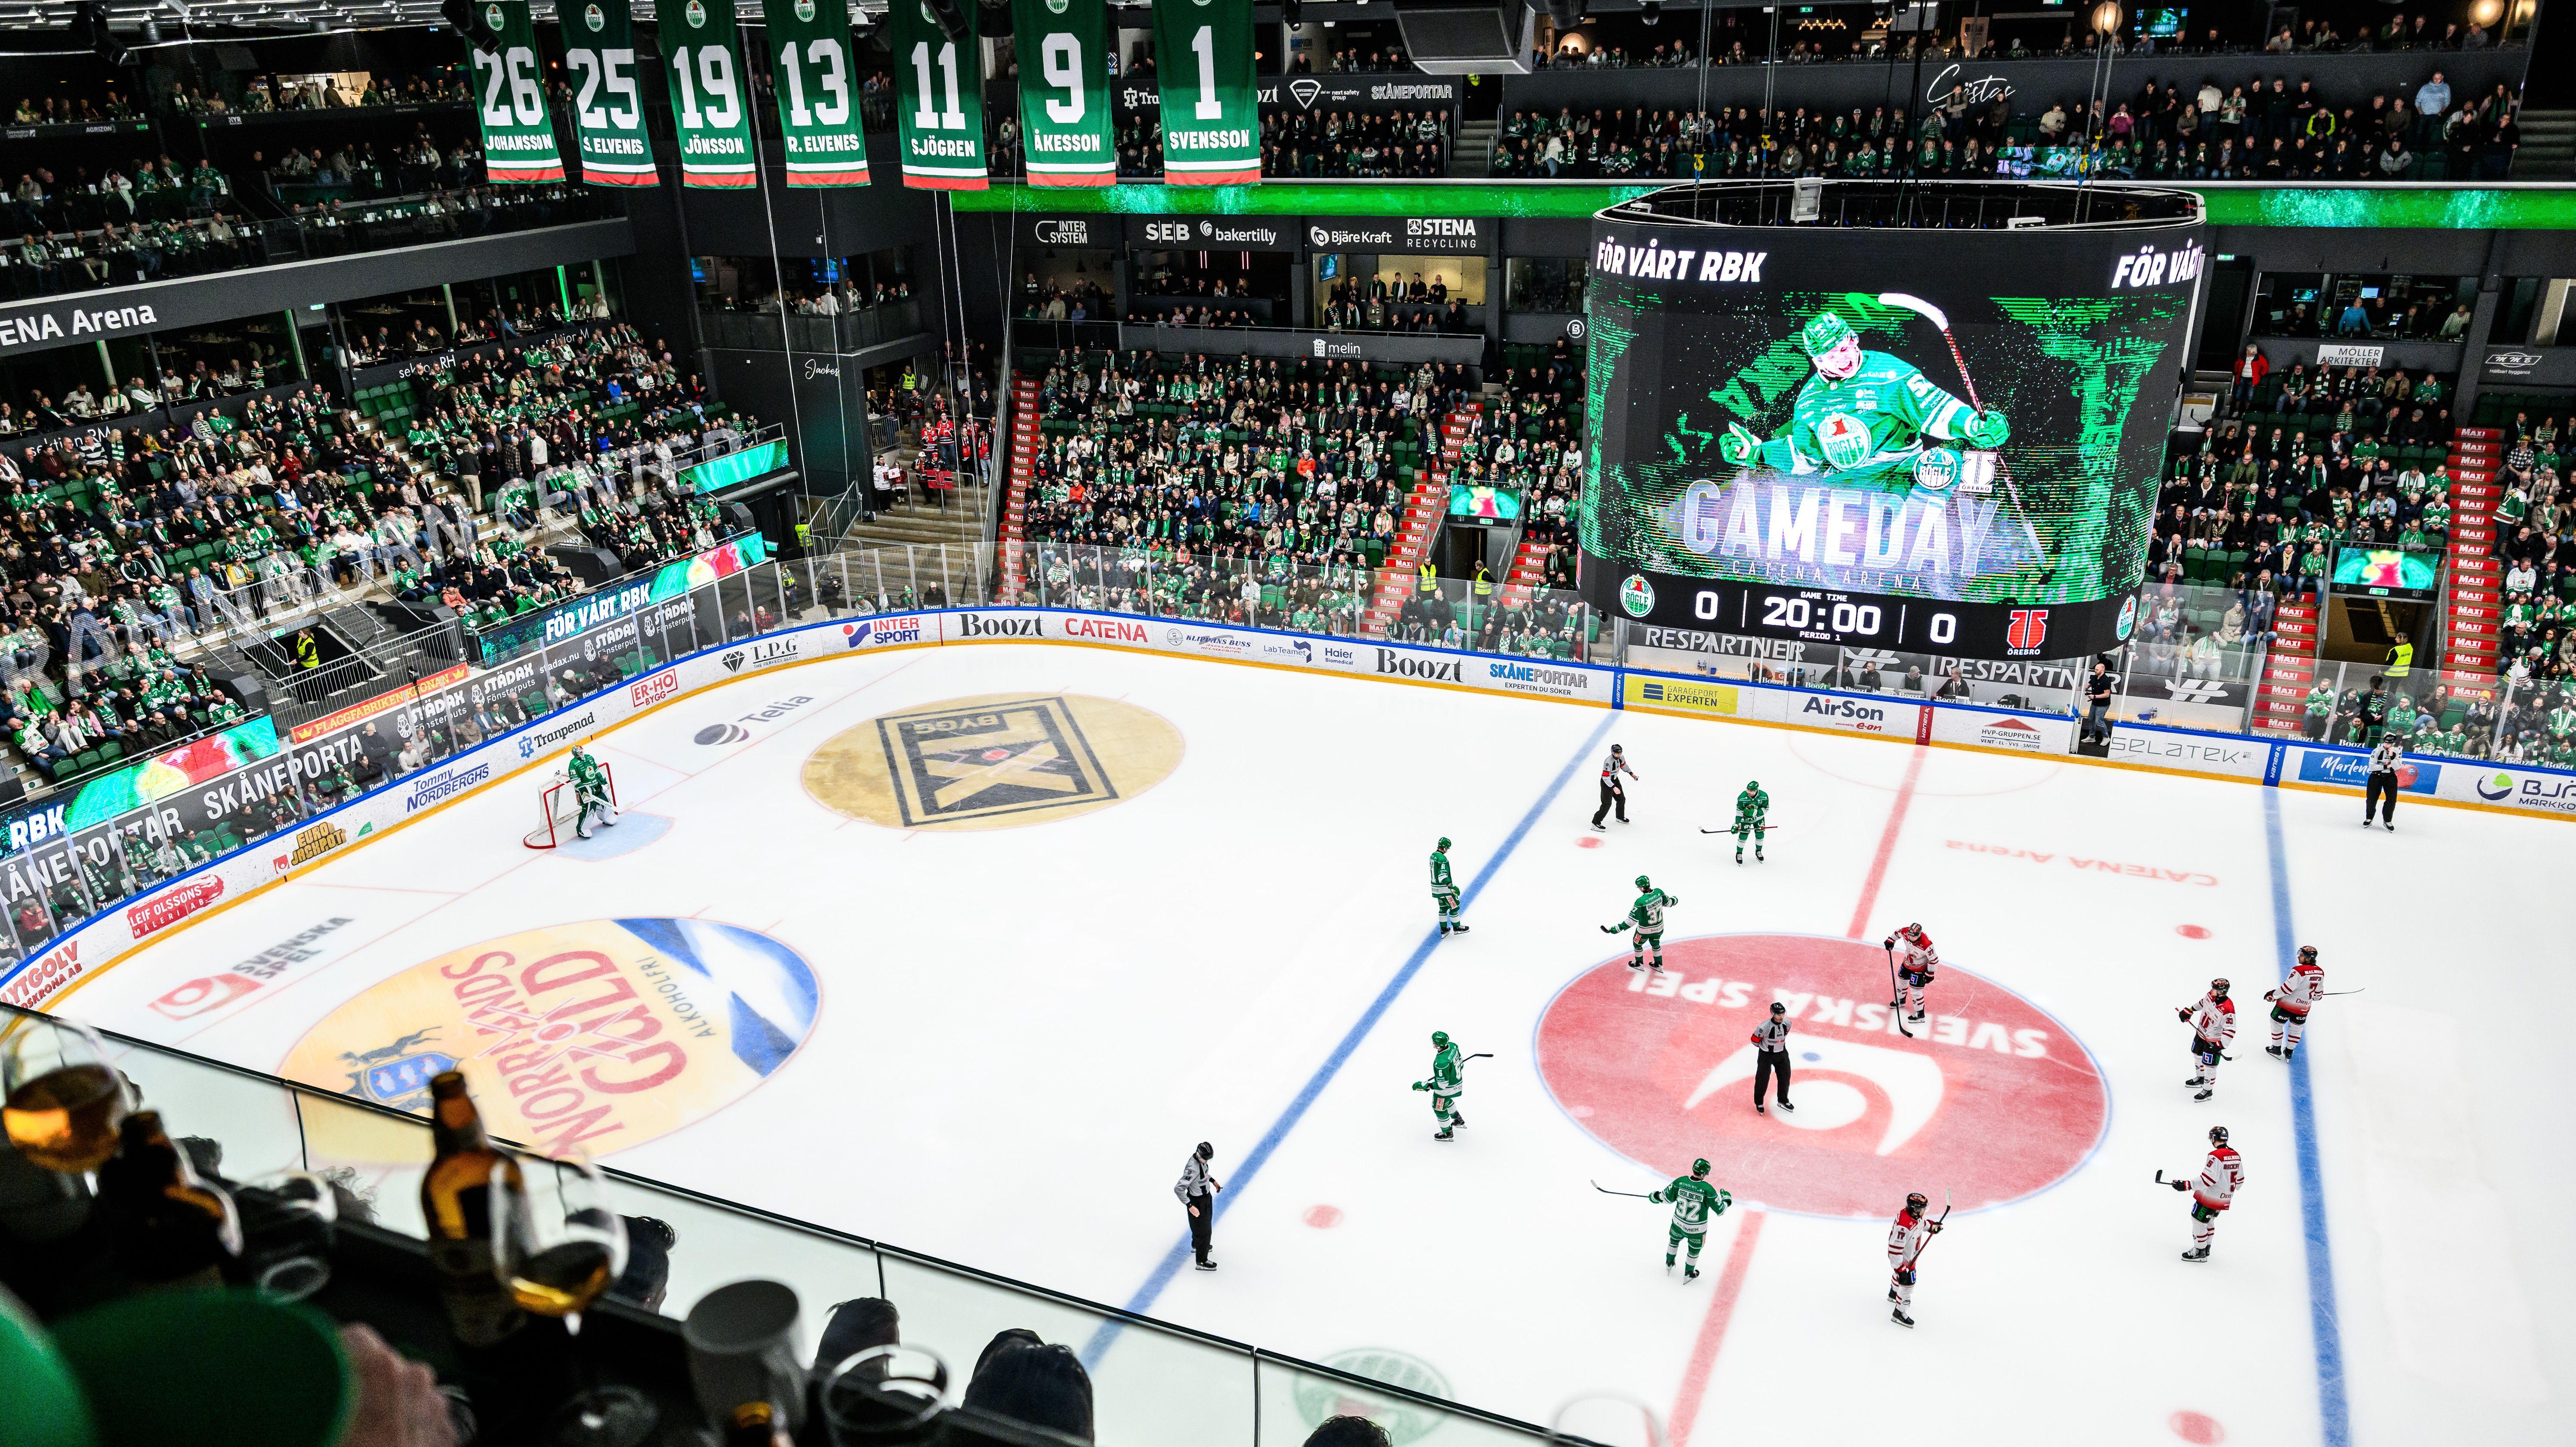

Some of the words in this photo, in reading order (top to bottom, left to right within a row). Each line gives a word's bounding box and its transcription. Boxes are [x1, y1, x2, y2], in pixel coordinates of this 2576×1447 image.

[780, 39, 848, 126] 13
[1041, 33, 1085, 123] 9
[1192, 26, 1222, 120] 1
[474, 46, 543, 126] 26
[567, 49, 639, 129] 25
[673, 45, 741, 128] 19
[911, 42, 966, 130] 11
[1371, 83, 1452, 99] SKÅNEPORTAR
[485, 134, 553, 151] JOHANSSON
[595, 137, 643, 154] ELVENES
[685, 136, 744, 154] JÖNSSON
[788, 136, 802, 151] R.
[804, 134, 859, 151] ELVENES
[912, 135, 975, 157] SJÖGREN
[1034, 129, 1100, 151] ÅKESSON
[1170, 130, 1249, 149] SVENSSON
[1059, 221, 1086, 232] INTER
[1146, 222, 1190, 242] SEB
[1216, 228, 1277, 245] bakertilly
[1423, 219, 1476, 236] STENA
[1050, 232, 1088, 244] SYSTEM
[1332, 231, 1360, 245] Bjäre
[1362, 231, 1392, 243] Kraft
[1407, 239, 1476, 248] RECYCLING
[1596, 239, 1625, 275] FÖR
[1628, 238, 1695, 281] VÅRT
[1699, 251, 1768, 283] RBK
[2111, 244, 2166, 288] FÖR
[0, 314, 64, 346] ENA
[72, 305, 157, 335] Arena
[1328, 342, 1361, 355] melin
[2339, 347, 2380, 357] MÖLLER
[440, 355, 456, 369] RH
[805, 359, 840, 379] Jackes
[2320, 356, 2379, 366] ARKITEKTER
[1683, 479, 2000, 577] GAMEDAY
[1526, 557, 1544, 565] MAXI
[1733, 559, 1823, 583] CATENA
[1845, 570, 1922, 590] ARENA
[1696, 591, 1718, 620] 0
[1801, 591, 1823, 600] GAME
[1826, 593, 1848, 602] TIME
[546, 610, 575, 641] FÖR
[578, 596, 616, 628] VÅRT
[621, 583, 651, 612] RBK
[826, 614, 843, 622] Boozt
[1762, 599, 1881, 636] 20:00
[2279, 608, 2303, 616] MAXI
[874, 618, 919, 631] INTER
[960, 613, 1044, 636] Boozt
[1065, 618, 1148, 643] CATENA
[1799, 631, 1831, 640] PERIOD
[1931, 614, 1955, 644] 0
[875, 629, 920, 644] SPORT
[1186, 635, 1227, 646] KLIPPANS
[1229, 639, 1251, 648] BUSS
[1645, 627, 1806, 663] RESPARTNER
[2276, 639, 2300, 647] MAXI
[751, 638, 797, 660] T.P.G
[1264, 645, 1276, 653] Lab
[1277, 647, 1306, 657] Teamet
[1325, 648, 1352, 659] Haier
[2007, 646, 2041, 656] ÖREBRO
[1375, 648, 1463, 683] Boozt
[1490, 663, 1587, 688] SKÅNEPORTAR
[484, 663, 534, 694] STÄDAX
[635, 674, 673, 701] ER-HO
[1505, 682, 1537, 692] EXPERTEN
[1547, 685, 1571, 696] SÖKER
[1805, 682, 1827, 690] Boozt
[487, 679, 536, 703] Fönsterputs
[645, 691, 666, 706] BYGG
[1667, 693, 1717, 707] EXPERTEN
[1668, 685, 1718, 697] GARAGEPORT
[315, 690, 404, 734] FLAGGFABRIKEN
[737, 695, 814, 723] Telia
[1804, 696, 1884, 722] AirSon
[534, 712, 595, 748] Tranpenad
[1981, 728, 2041, 741] HVP-GRUPPEN.SE
[2253, 730, 2278, 740] Boozt
[204, 731, 365, 820] SKÅNEPORTA
[2271, 752, 2280, 779] BAUER
[407, 765, 489, 813] NORDBERGHS
[415, 768, 453, 793] Tommy
[9, 804, 65, 850] RBK
[297, 822, 330, 848] EURO
[292, 829, 347, 866] JACKPOT
[1946, 839, 2055, 863] Arena
[2069, 856, 2218, 886] CATENA
[142, 876, 165, 891] Boozt
[130, 909, 151, 928] LEIF
[155, 885, 202, 916] OLSSONS
[1647, 905, 1663, 924] 37
[134, 910, 180, 938] MÅLERI
[191, 899, 204, 910] AB
[232, 917, 355, 974] SVENSKA
[68, 963, 82, 978] AB
[253, 949, 323, 979] SPEL
[636, 956, 716, 1039] ALKOHOLFRI
[1628, 968, 1754, 1008] SPEL
[2308, 983, 2318, 1000] 7
[1774, 989, 2048, 1058] SVENSKA
[441, 951, 626, 1160] NORRLANDS
[2230, 1171, 2238, 1192] 5
[1679, 1190, 1702, 1201] SOLBERG
[1676, 1198, 1701, 1221] 32
[1897, 1231, 1906, 1240] 17
